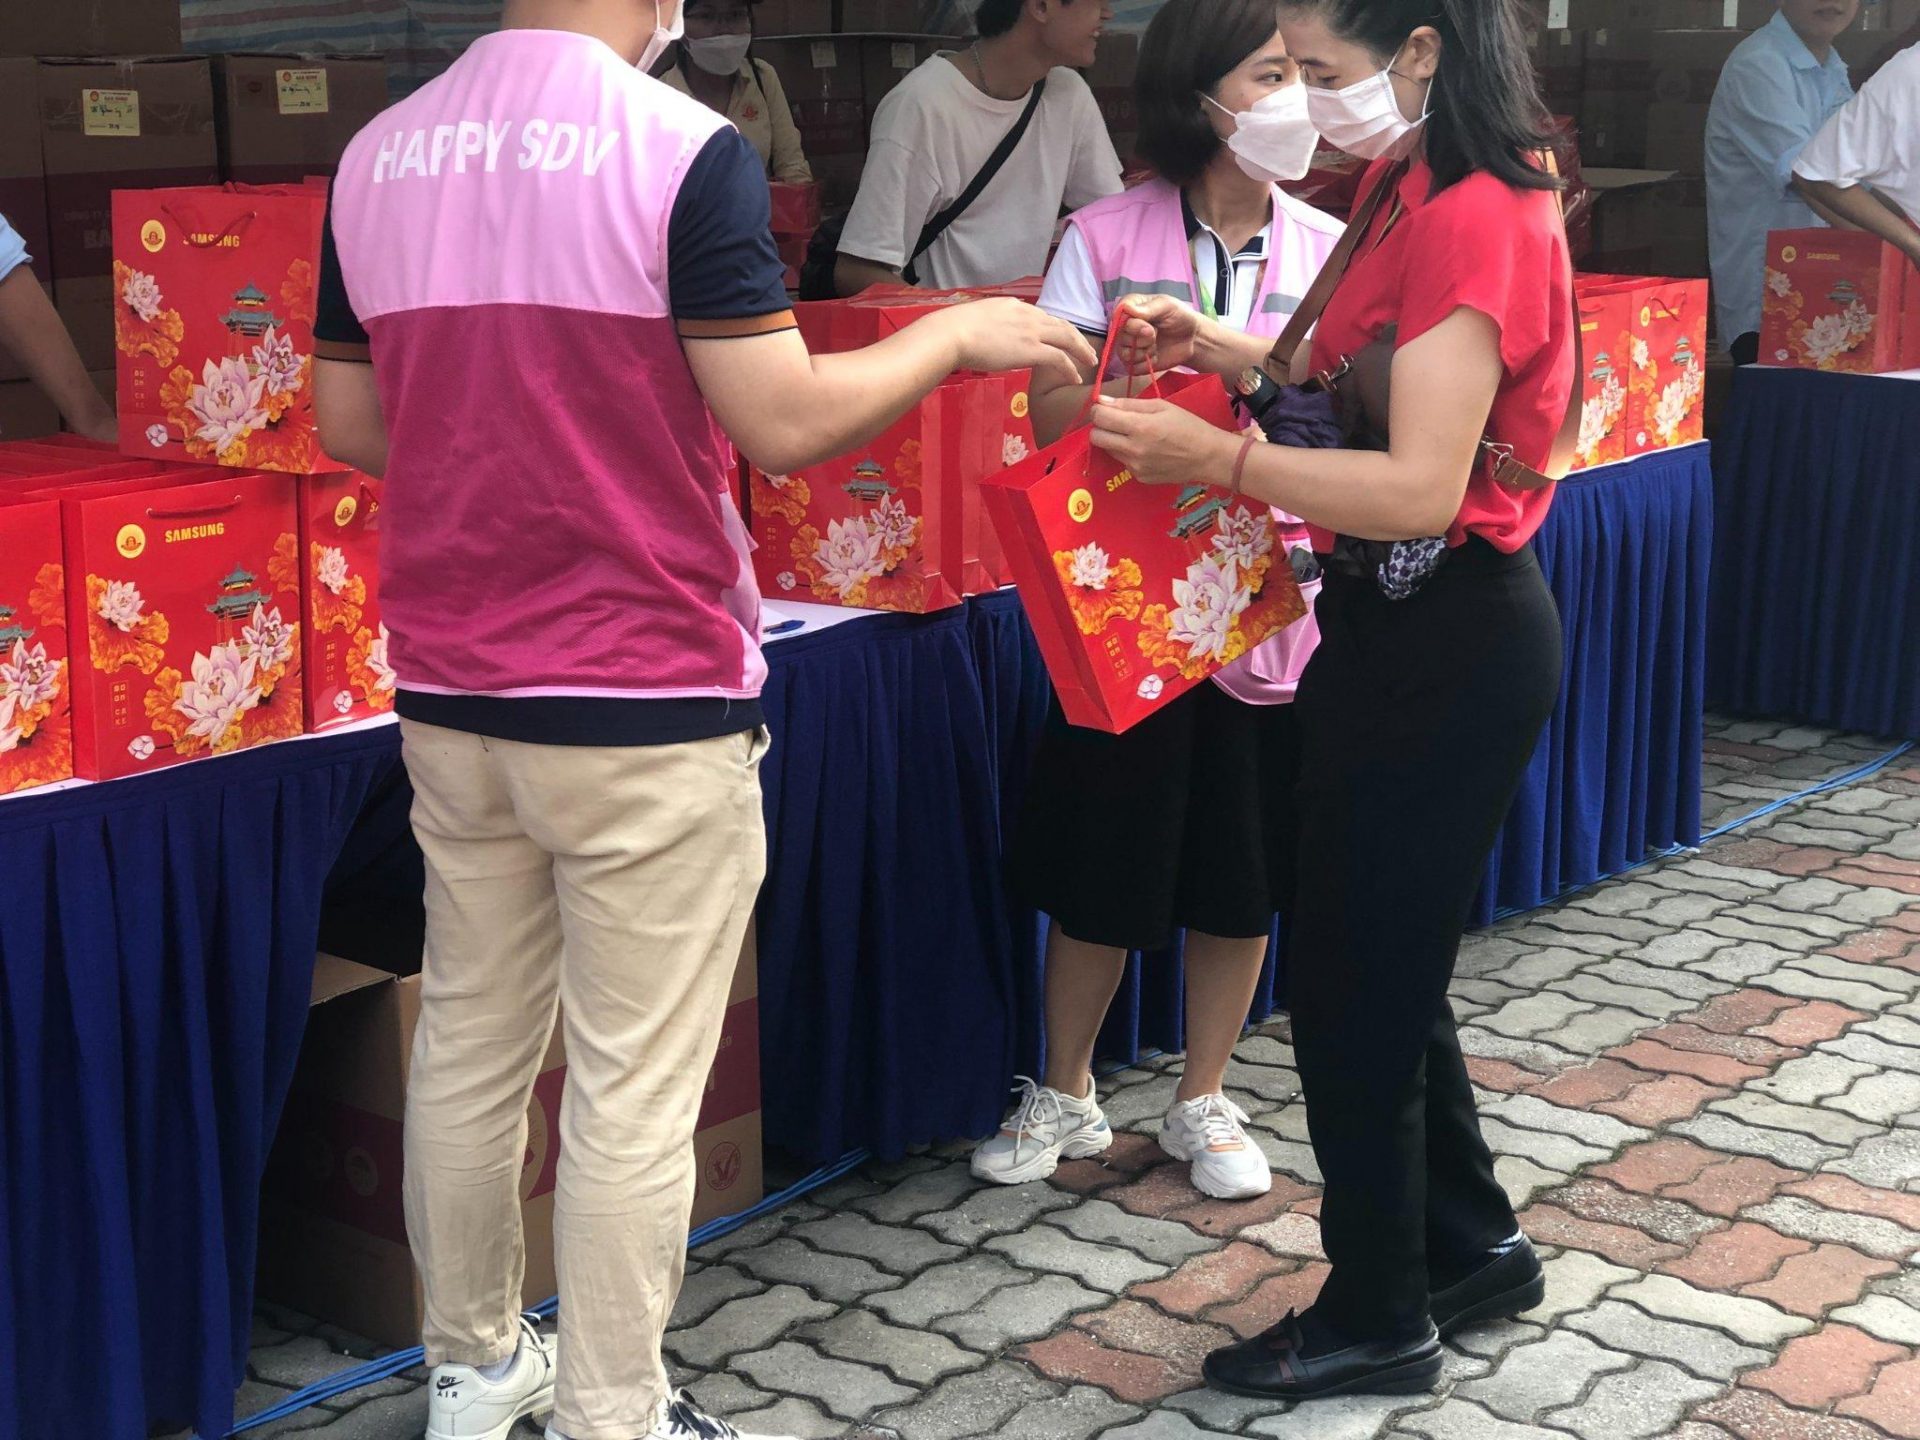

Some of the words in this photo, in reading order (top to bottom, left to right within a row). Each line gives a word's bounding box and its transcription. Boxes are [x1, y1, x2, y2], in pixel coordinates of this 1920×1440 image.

[373, 119, 512, 183] HAPPY
[517, 118, 620, 177] SDV
[165, 522, 225, 543] SAMSUNG
[437, 1390, 458, 1399] AIR
